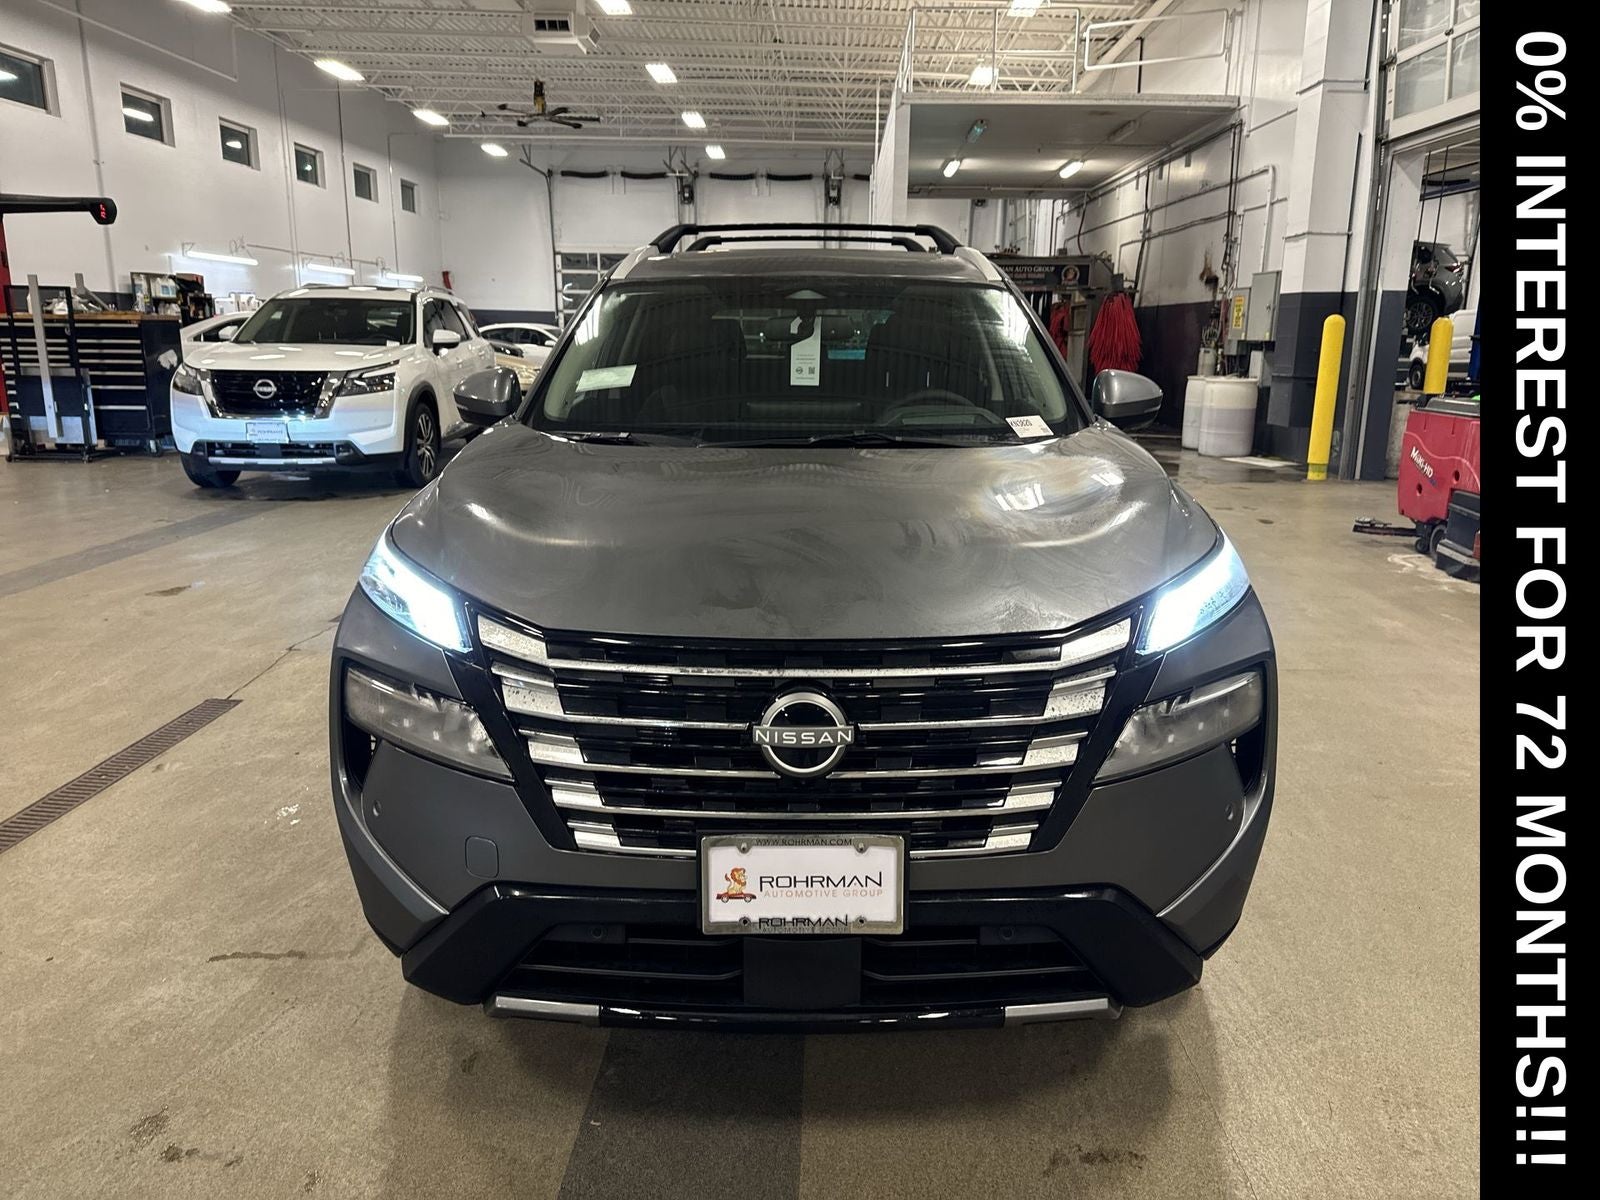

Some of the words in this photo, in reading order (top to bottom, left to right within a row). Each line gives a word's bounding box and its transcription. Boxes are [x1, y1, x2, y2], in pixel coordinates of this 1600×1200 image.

[755, 729, 852, 745] NISSAN
[755, 838, 853, 846] WWW.ROHRMAN.COM
[759, 871, 882, 892] ROHRMAN
[764, 890, 837, 898] AUTOMOTIVE
[843, 889, 883, 897] GROUP
[758, 914, 848, 929] ROHRMAN
